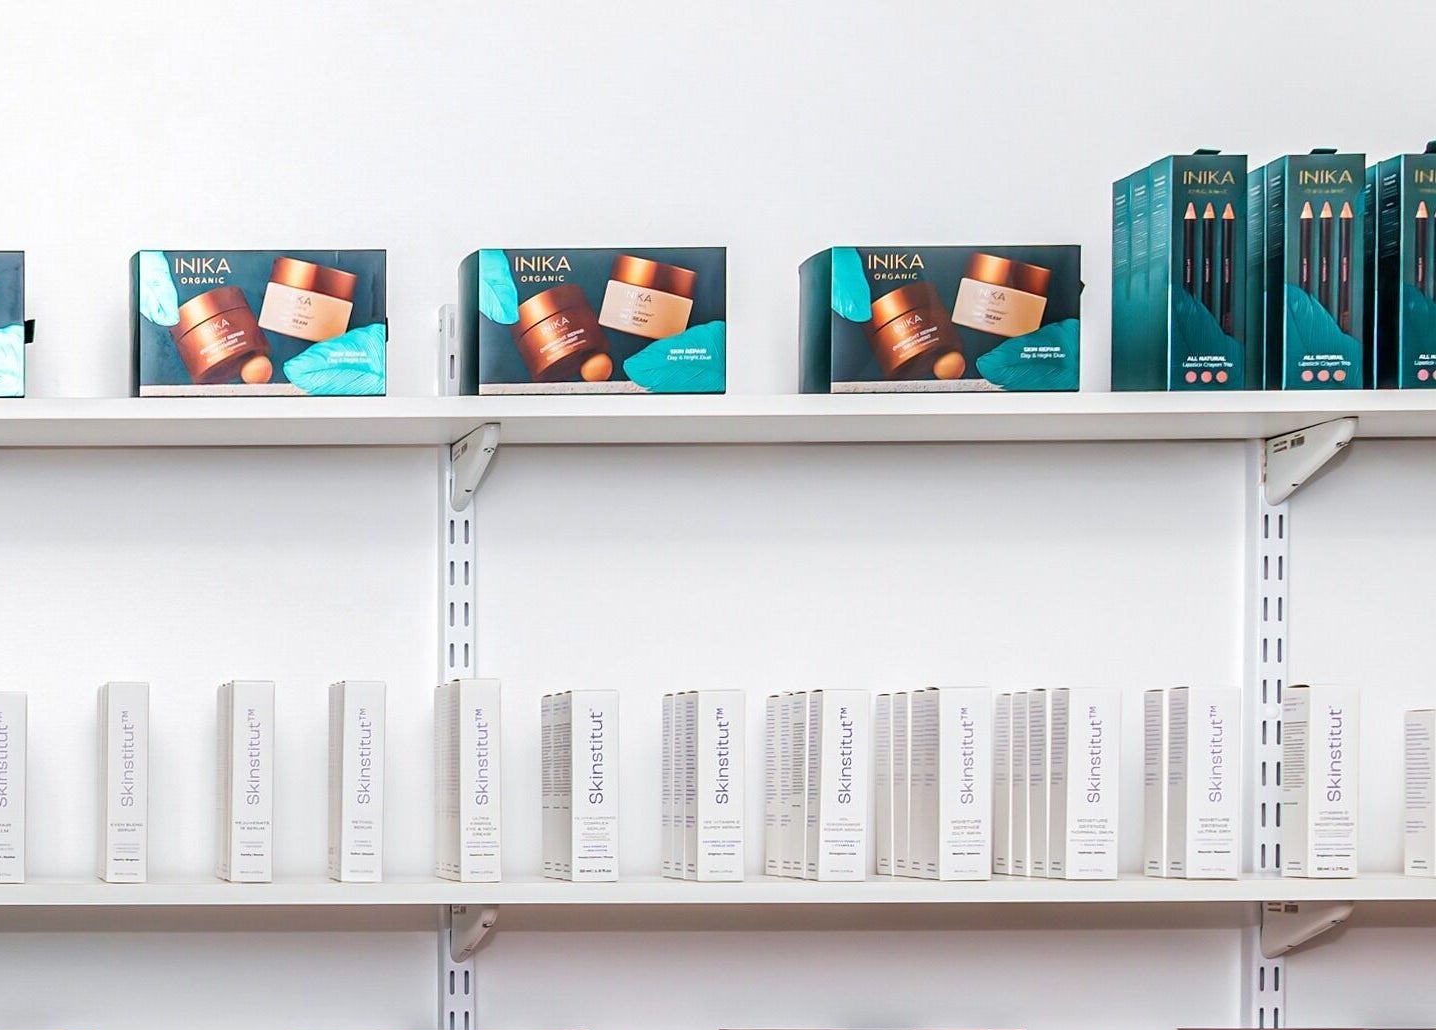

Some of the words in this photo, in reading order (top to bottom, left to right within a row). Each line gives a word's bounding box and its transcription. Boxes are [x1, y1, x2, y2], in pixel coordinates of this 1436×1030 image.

[1183, 170, 1235, 185] INIKA
[1299, 169, 1354, 185] INIKA
[174, 257, 232, 274] INIKA
[180, 277, 225, 285] ORGANIC
[515, 255, 572, 273] INIKA
[520, 274, 565, 283] ORGANIC
[868, 253, 925, 270] INIKA
[874, 272, 918, 281] ORGANIC
[120, 709, 135, 807] Skinstitut™
[246, 708, 261, 806] Skinstitut™
[357, 707, 372, 805] Skinstitut™
[475, 708, 489, 806] Skinstitut™
[715, 707, 731, 805] Skinstitut™
[837, 706, 854, 805] Skinstitut™
[960, 707, 975, 805] Skinstitut™
[1086, 704, 1103, 804] Skinstitut™
[1208, 704, 1225, 804] Skinstitut™
